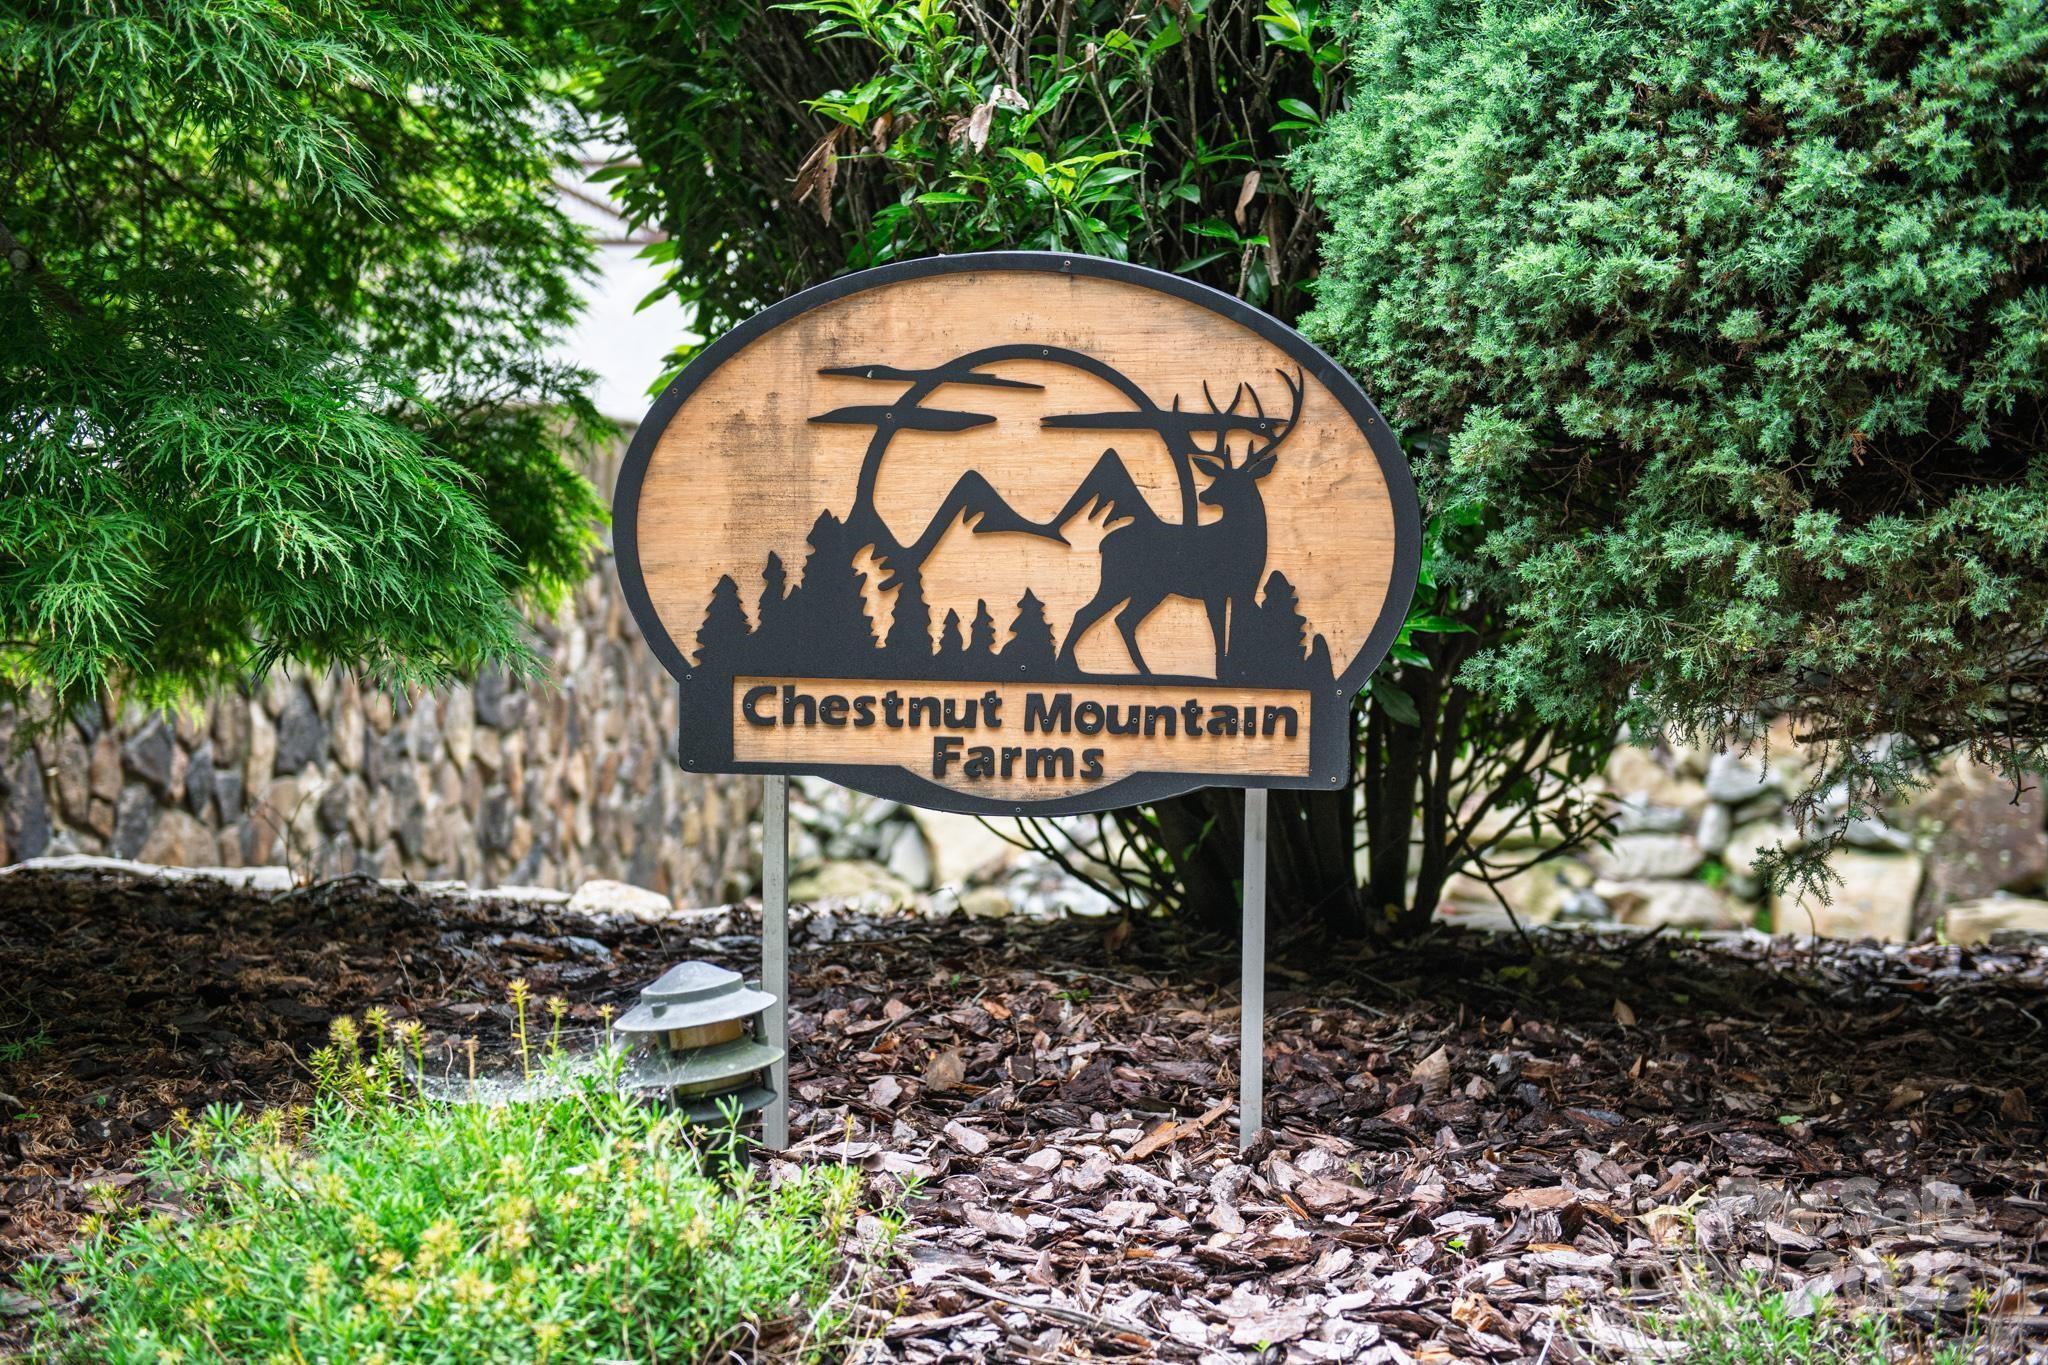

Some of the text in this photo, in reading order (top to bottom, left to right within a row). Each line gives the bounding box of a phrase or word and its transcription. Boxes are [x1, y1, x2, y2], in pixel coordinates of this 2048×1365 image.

[742, 685, 1298, 737] Chestnut Mountain
[933, 736, 1104, 779] Farms
